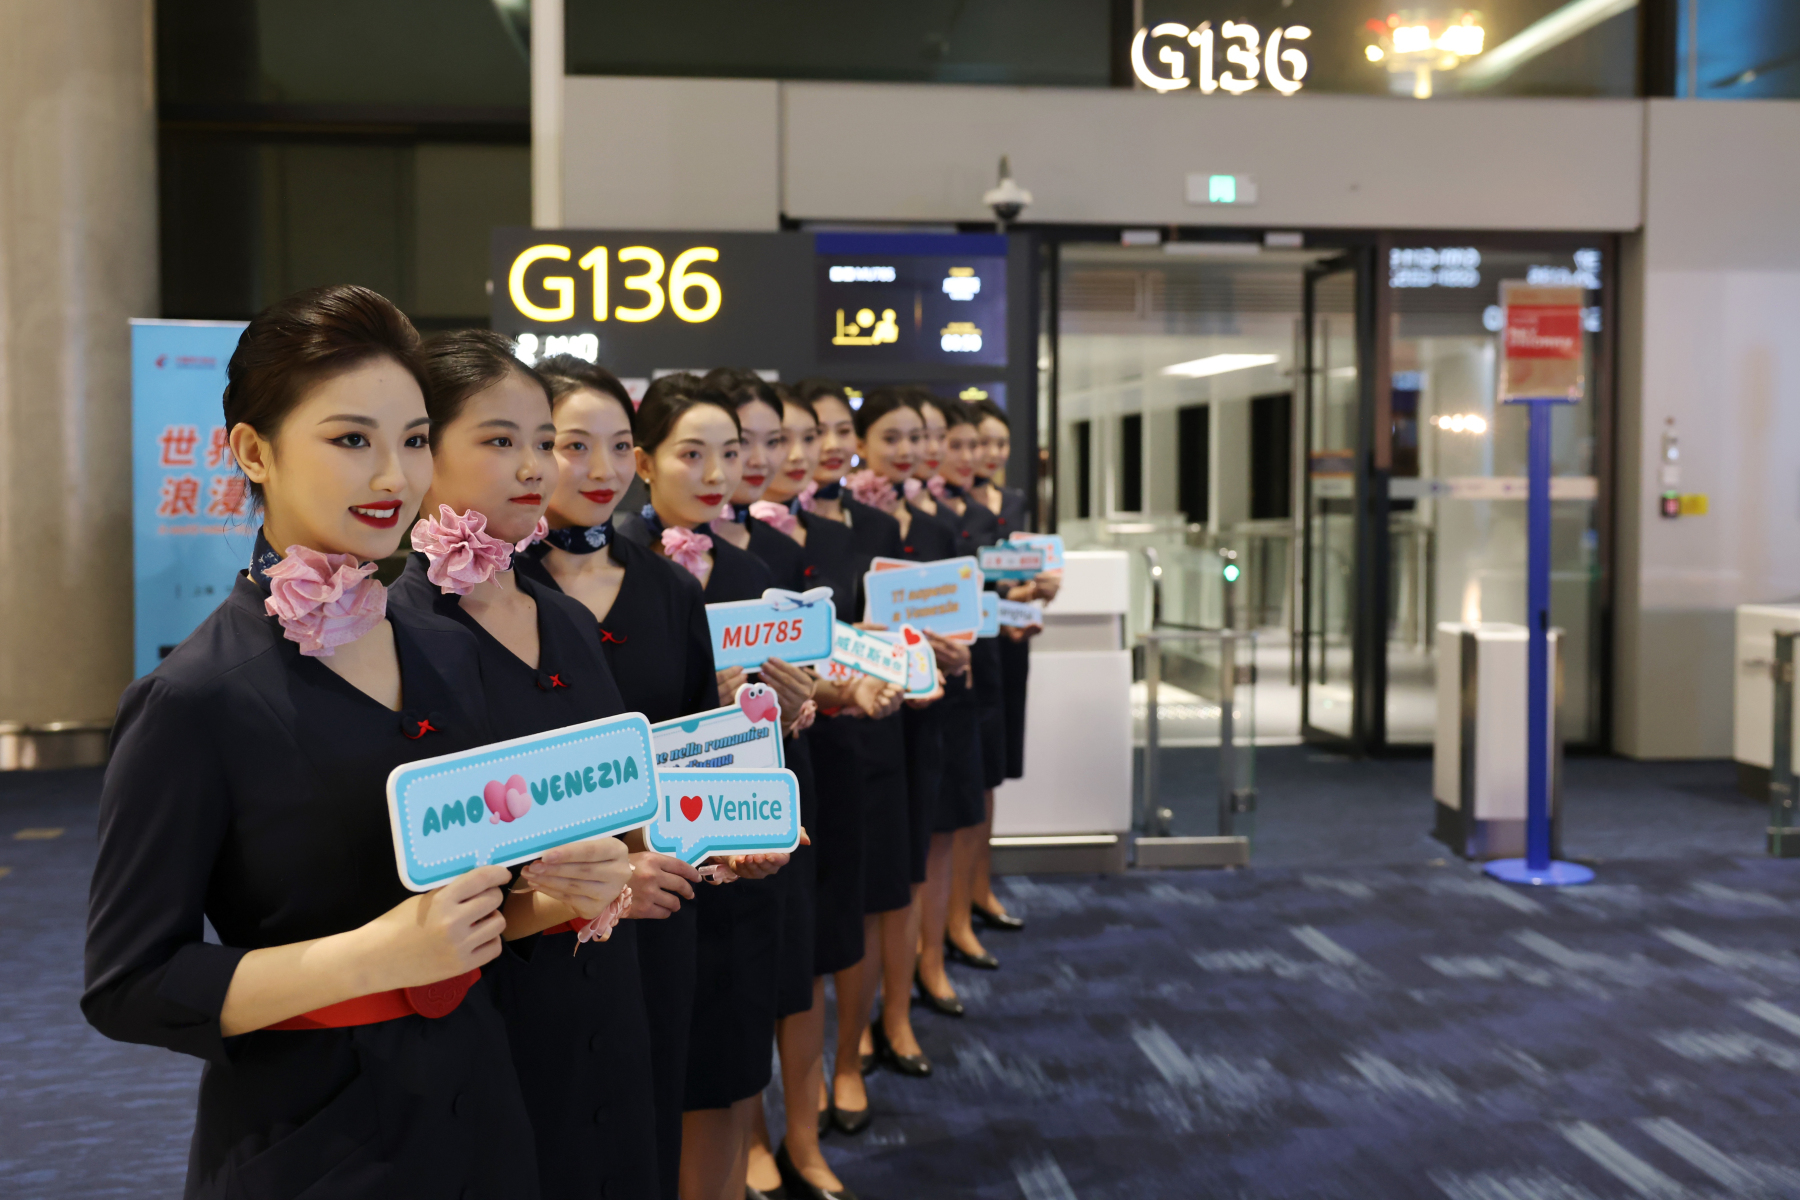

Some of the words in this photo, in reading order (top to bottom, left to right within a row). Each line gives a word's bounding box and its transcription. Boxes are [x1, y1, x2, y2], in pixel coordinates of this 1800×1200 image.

[1130, 20, 1312, 95] G136
[508, 243, 722, 324] G136
[722, 618, 803, 649] MU785
[669, 742, 702, 761] nella
[704, 726, 769, 752] romantica
[422, 795, 484, 837] AMO
[530, 755, 639, 806] VENEZIA
[665, 796, 670, 822] I
[709, 792, 782, 821] Venice
